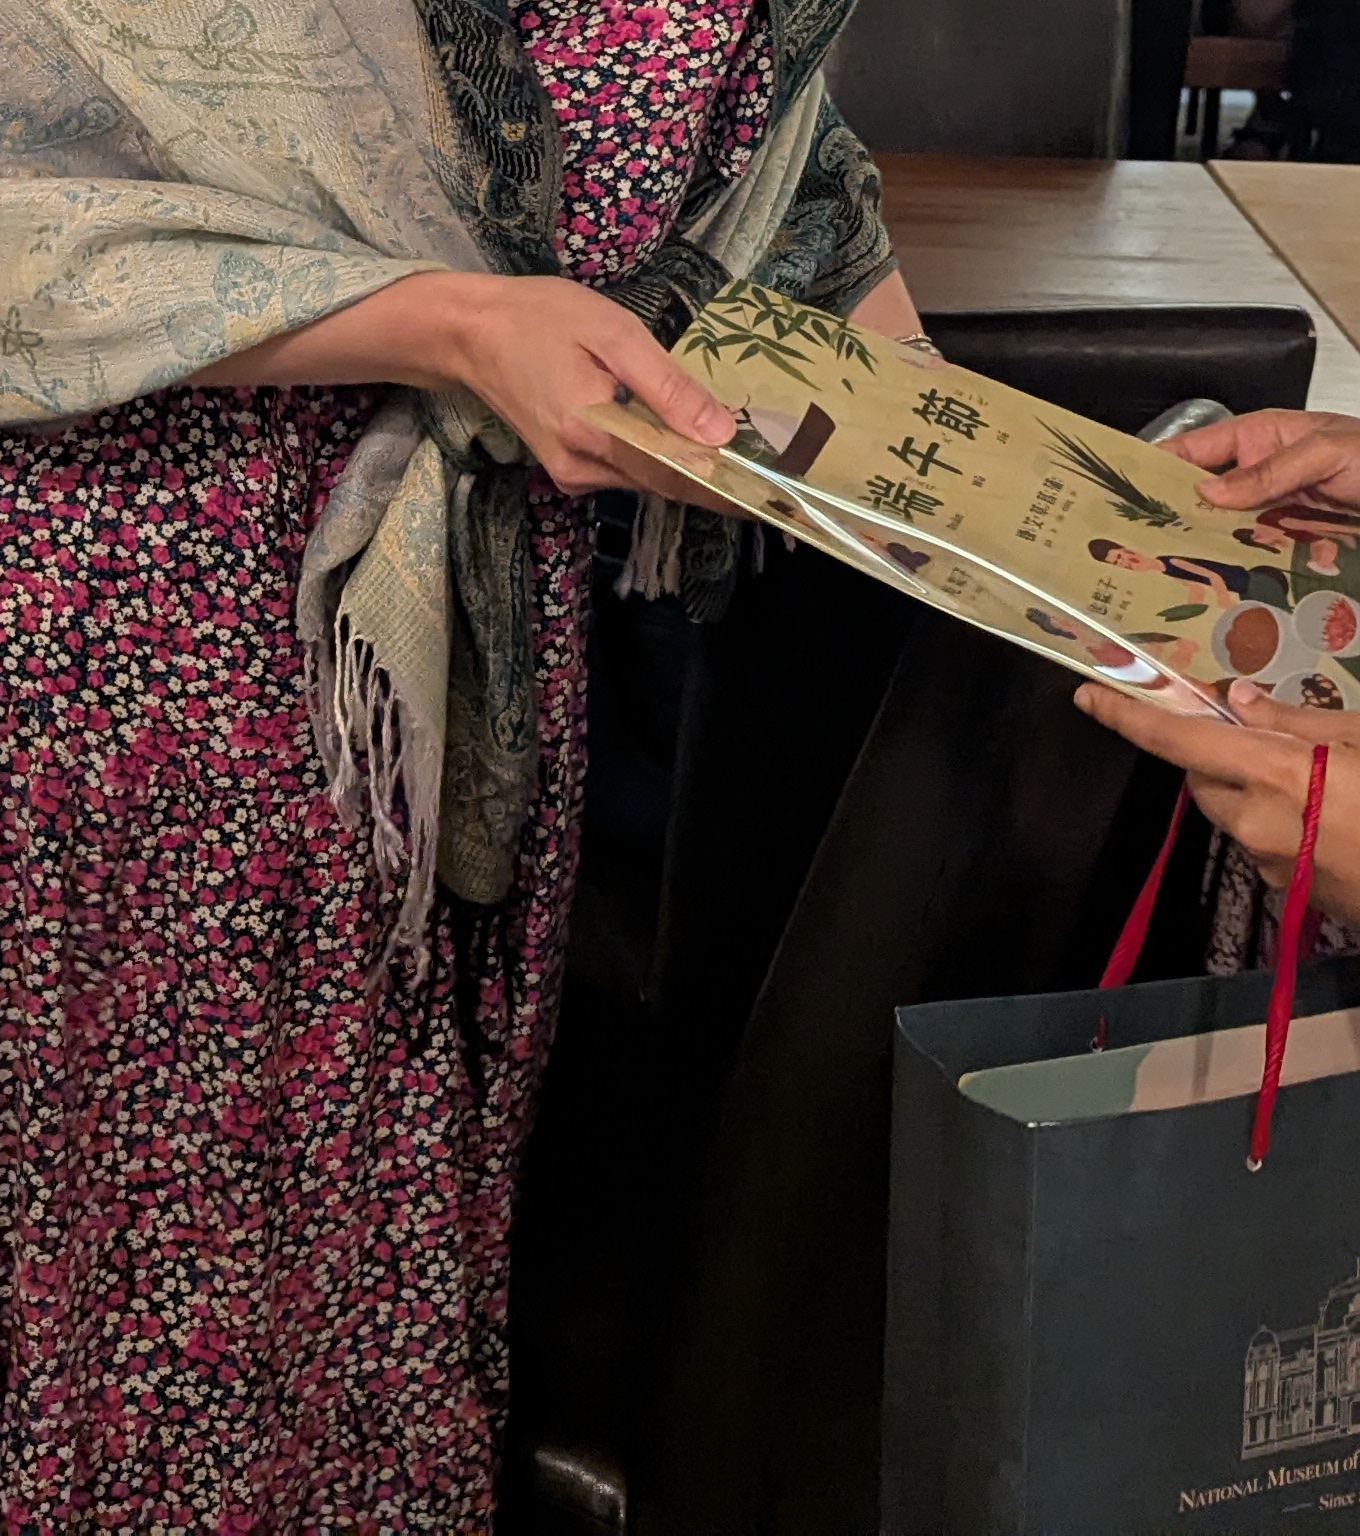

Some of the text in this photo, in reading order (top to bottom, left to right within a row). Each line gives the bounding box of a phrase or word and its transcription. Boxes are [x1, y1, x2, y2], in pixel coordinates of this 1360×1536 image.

[857, 388, 991, 524] 端午節
[1178, 1478, 1263, 1512] NATIONAL
[1267, 1460, 1340, 1489] MUSEUM
[1342, 1448, 1360, 1472] of
[1318, 1492, 1356, 1511] Since
